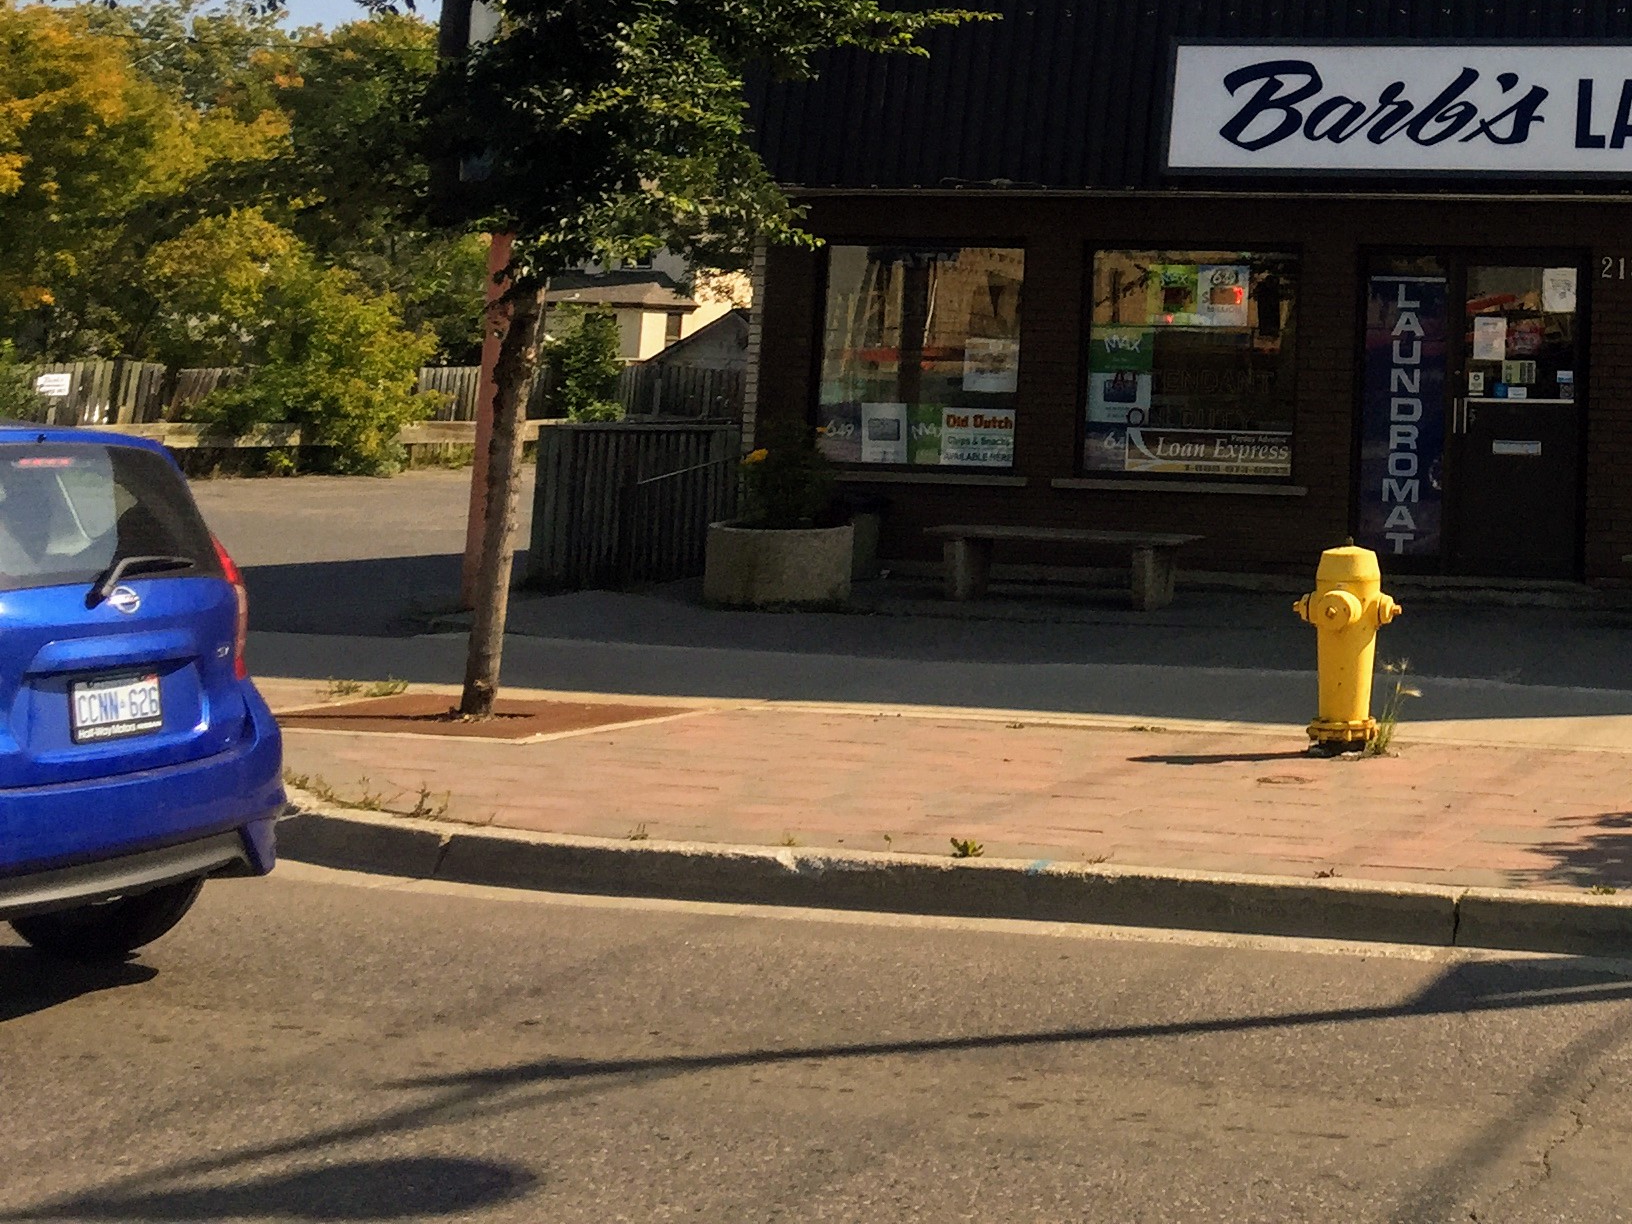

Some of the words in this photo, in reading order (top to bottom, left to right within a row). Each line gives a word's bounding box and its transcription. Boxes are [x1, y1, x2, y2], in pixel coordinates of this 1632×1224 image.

[1219, 59, 1548, 153] Barb's
[973, 414, 1013, 430] Dutch
[1156, 436, 1206, 458] Loan
[1212, 438, 1289, 462] Express
[1381, 283, 1425, 555] LAUNDROMAT
